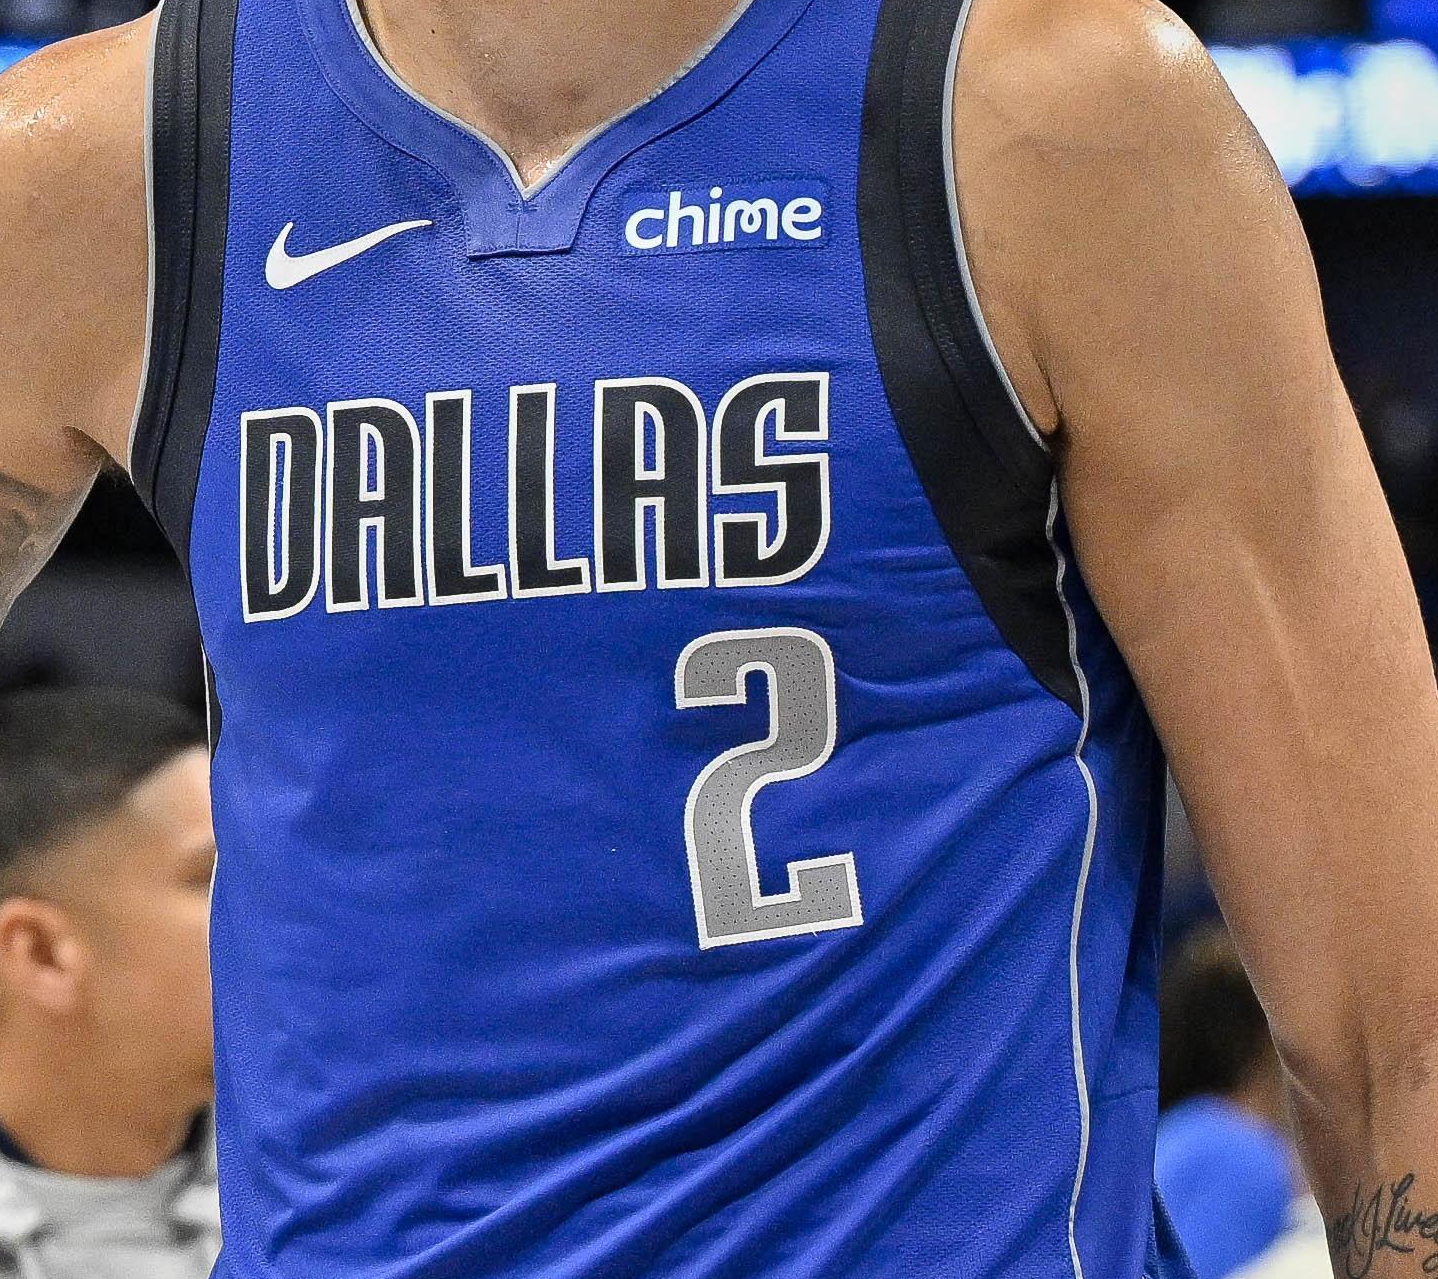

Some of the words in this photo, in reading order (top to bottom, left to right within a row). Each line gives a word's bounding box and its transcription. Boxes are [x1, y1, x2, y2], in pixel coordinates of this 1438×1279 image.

[625, 187, 822, 250] chime
[239, 372, 832, 624] DALLAS
[674, 626, 864, 950] 2
